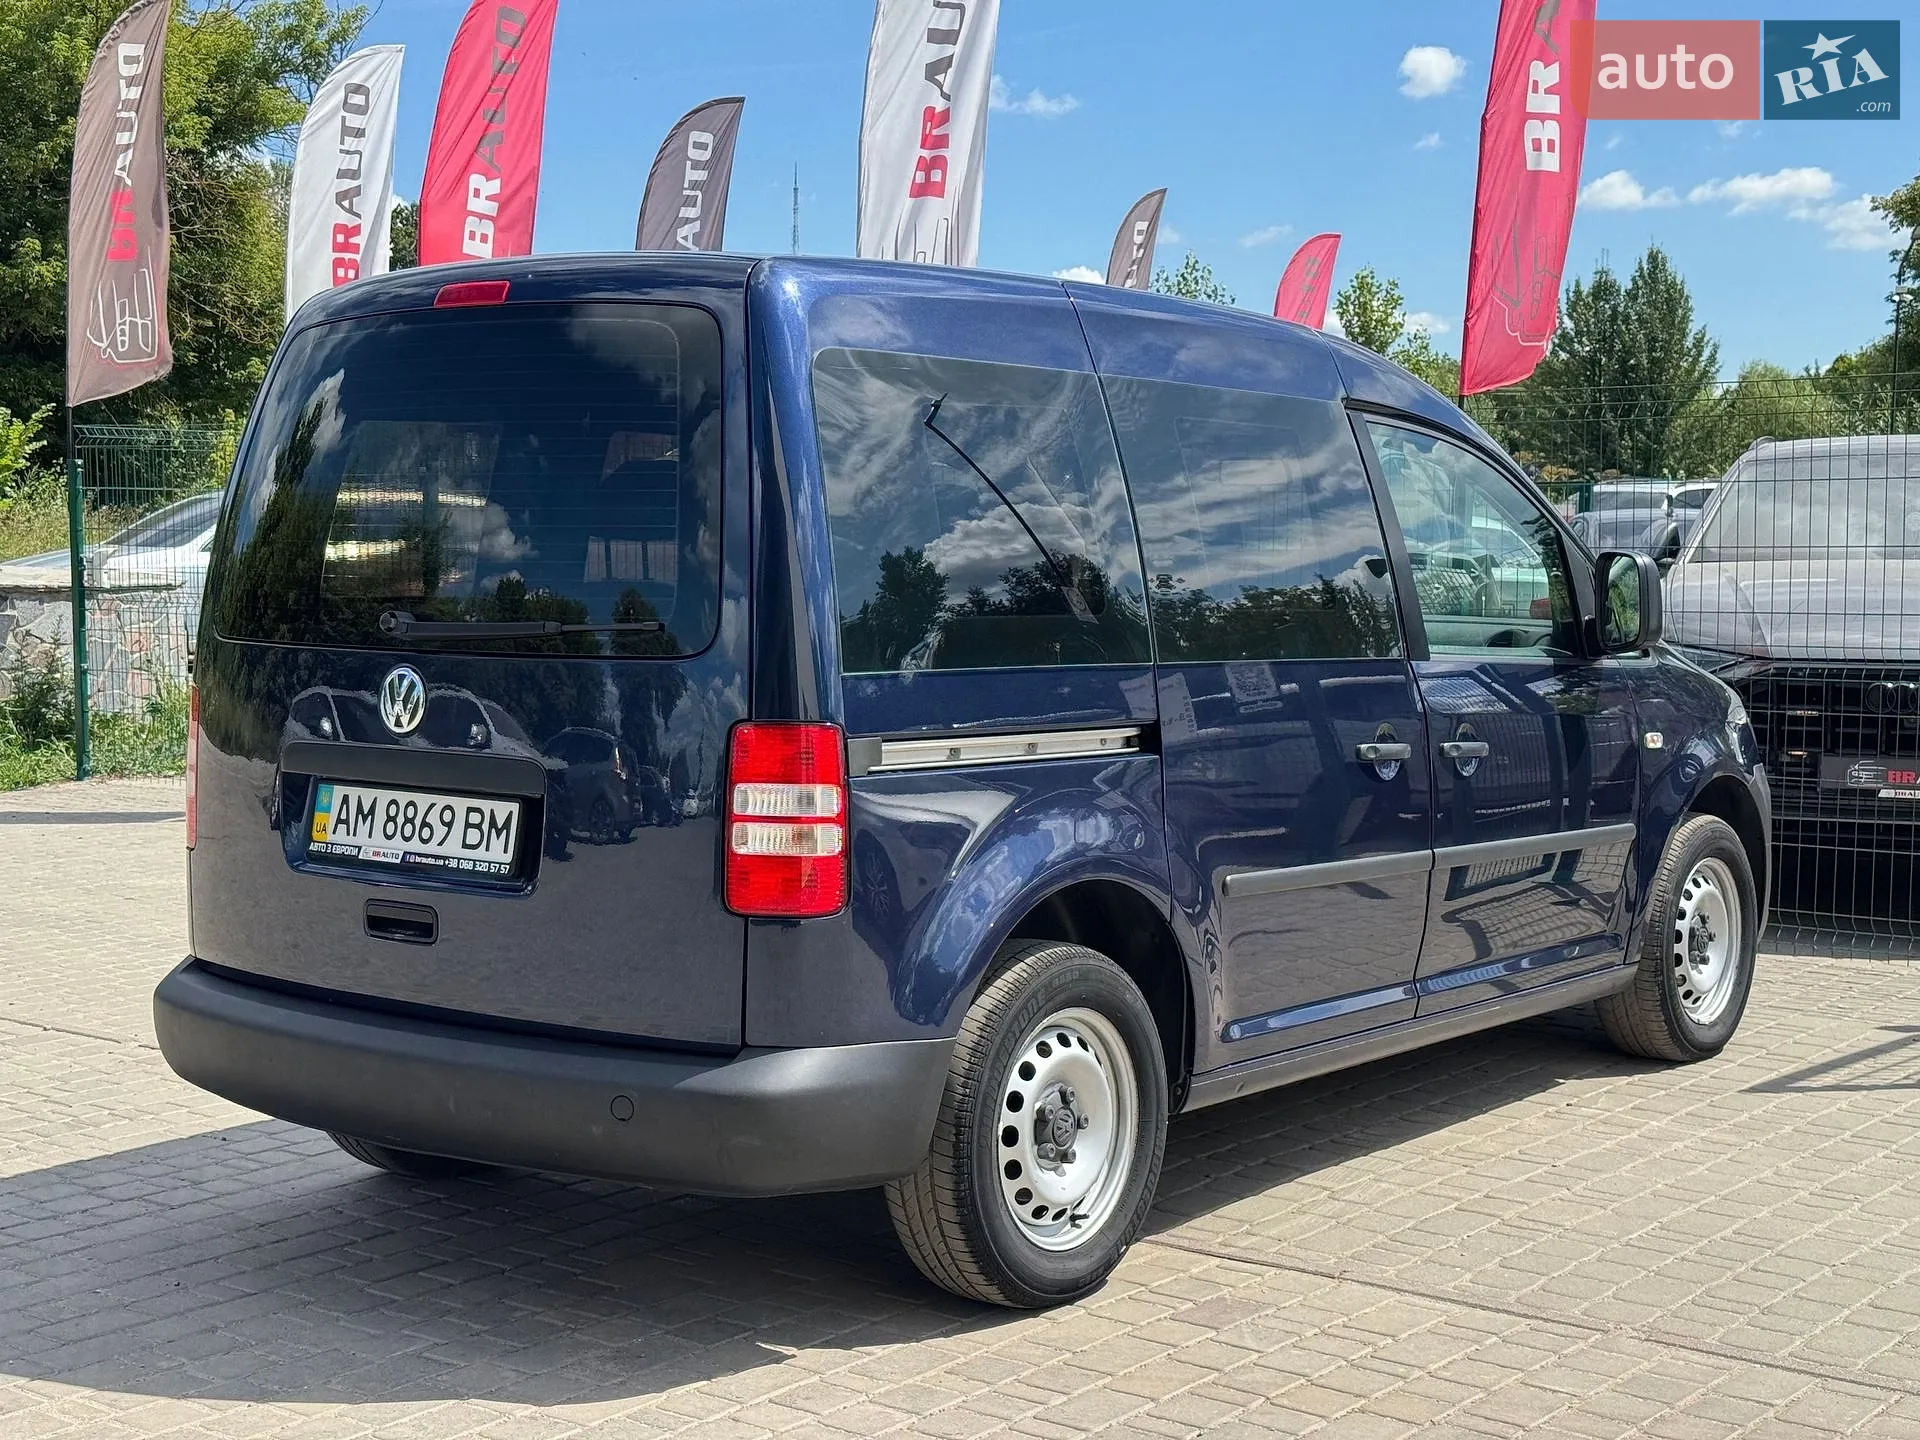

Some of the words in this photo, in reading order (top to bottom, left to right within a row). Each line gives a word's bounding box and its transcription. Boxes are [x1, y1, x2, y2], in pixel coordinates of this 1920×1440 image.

[106, 43, 146, 263] BRAUTO
[461, 5, 527, 259] BRAUTO
[332, 82, 371, 288] BRAUTO
[315, 821, 328, 834] UA
[332, 793, 378, 840] AM
[382, 798, 456, 848] 8869
[461, 806, 514, 855] BM
[371, 850, 400, 861] BRAUTO
[459, 860, 474, 870] 068
[474, 862, 489, 872] 320
[489, 864, 499, 873] 57
[500, 865, 510, 874] 57
